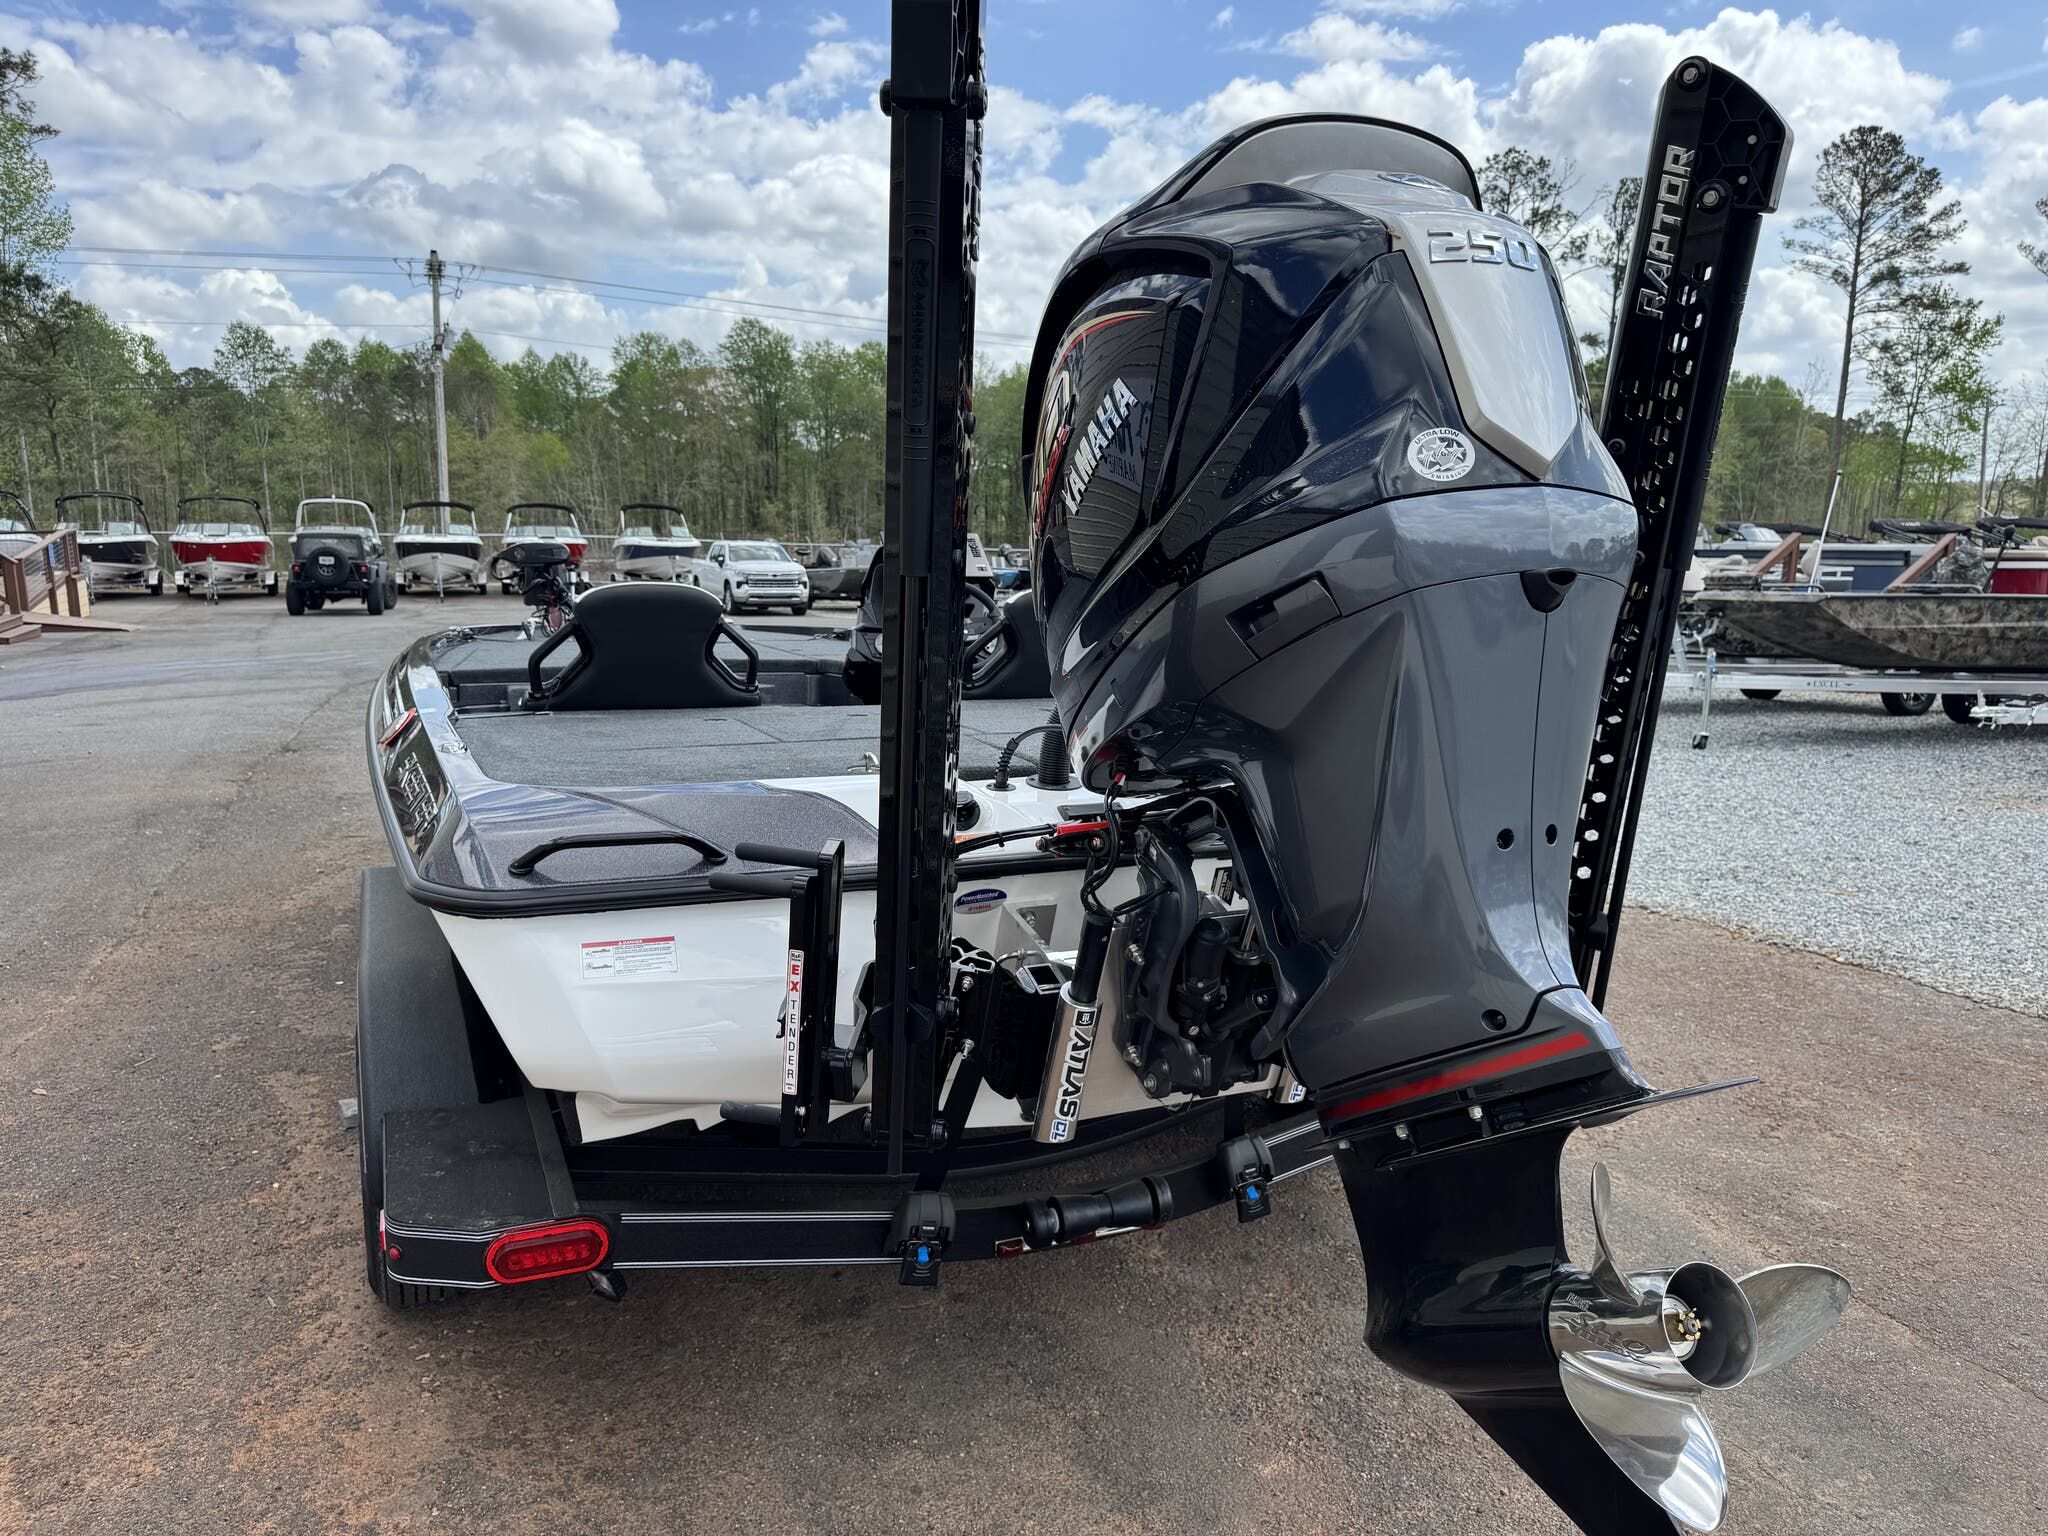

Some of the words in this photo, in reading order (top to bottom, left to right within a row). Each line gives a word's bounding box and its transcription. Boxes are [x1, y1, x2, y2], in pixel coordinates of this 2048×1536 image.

[1427, 228, 1538, 272] 250
[1636, 144, 1694, 320] RAPTOR
[1060, 377, 1139, 515] YAMAHA
[1059, 1030, 1091, 1118] ATLAS
